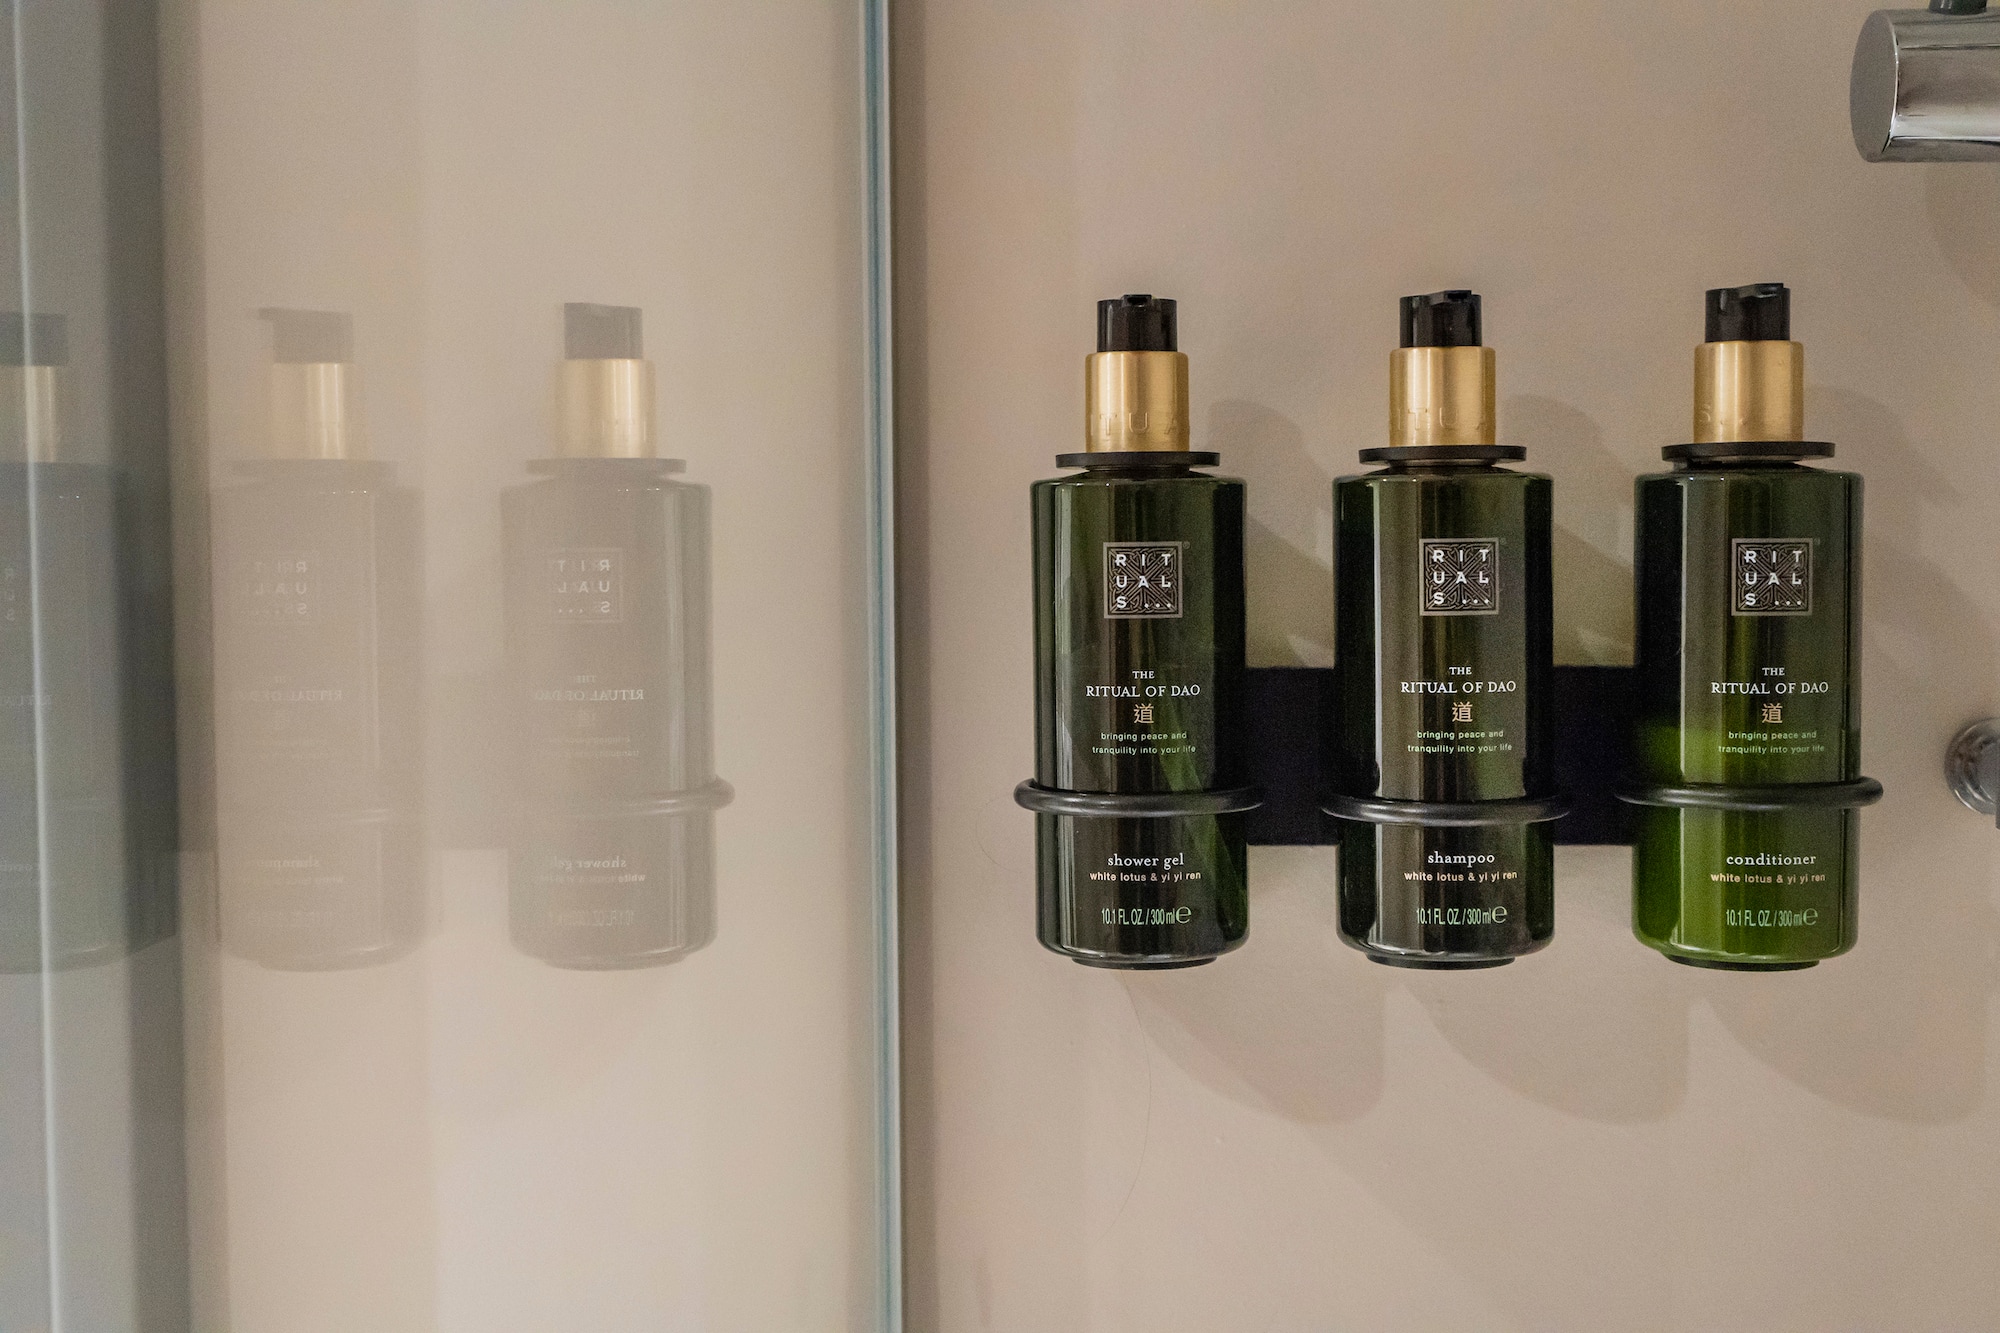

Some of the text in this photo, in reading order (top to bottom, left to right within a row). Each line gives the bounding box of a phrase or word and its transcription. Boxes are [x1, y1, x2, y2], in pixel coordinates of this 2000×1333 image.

[1132, 670, 1155, 679] THE
[1449, 666, 1472, 675] THE
[1762, 667, 1785, 676] THE
[1086, 684, 1200, 697] RITUAL OF DAO
[1401, 680, 1516, 693] RITUAL OF DAO
[1711, 682, 1829, 694] RITUAL OF DAO
[1134, 703, 1154, 724] 道
[1452, 702, 1473, 722] 道
[1762, 703, 1782, 724] 道
[1101, 732, 1137, 741] bringing
[1171, 731, 1187, 739] and
[1417, 730, 1504, 740] bringing peace and
[1728, 731, 1768, 741] bringing
[1771, 732, 1798, 740] peace
[1092, 745, 1196, 755] tranquility into your life
[1408, 743, 1512, 754] tranquility into your life
[1718, 746, 1767, 754] tranquility
[1770, 746, 1788, 754] into
[1791, 746, 1810, 754] your
[1108, 852, 1184, 870] shower gel
[1428, 851, 1495, 868] shampoo
[1726, 853, 1816, 866] conditioner
[1090, 871, 1201, 883] white lotus & yi yi ren
[1404, 871, 1518, 883] white lotus & yi yi ren
[1710, 873, 1825, 885] white lotus & yi yi ren
[1101, 908, 1116, 924] 10.1
[1416, 908, 1431, 924] 10.1
[1726, 909, 1742, 926] 10.1
